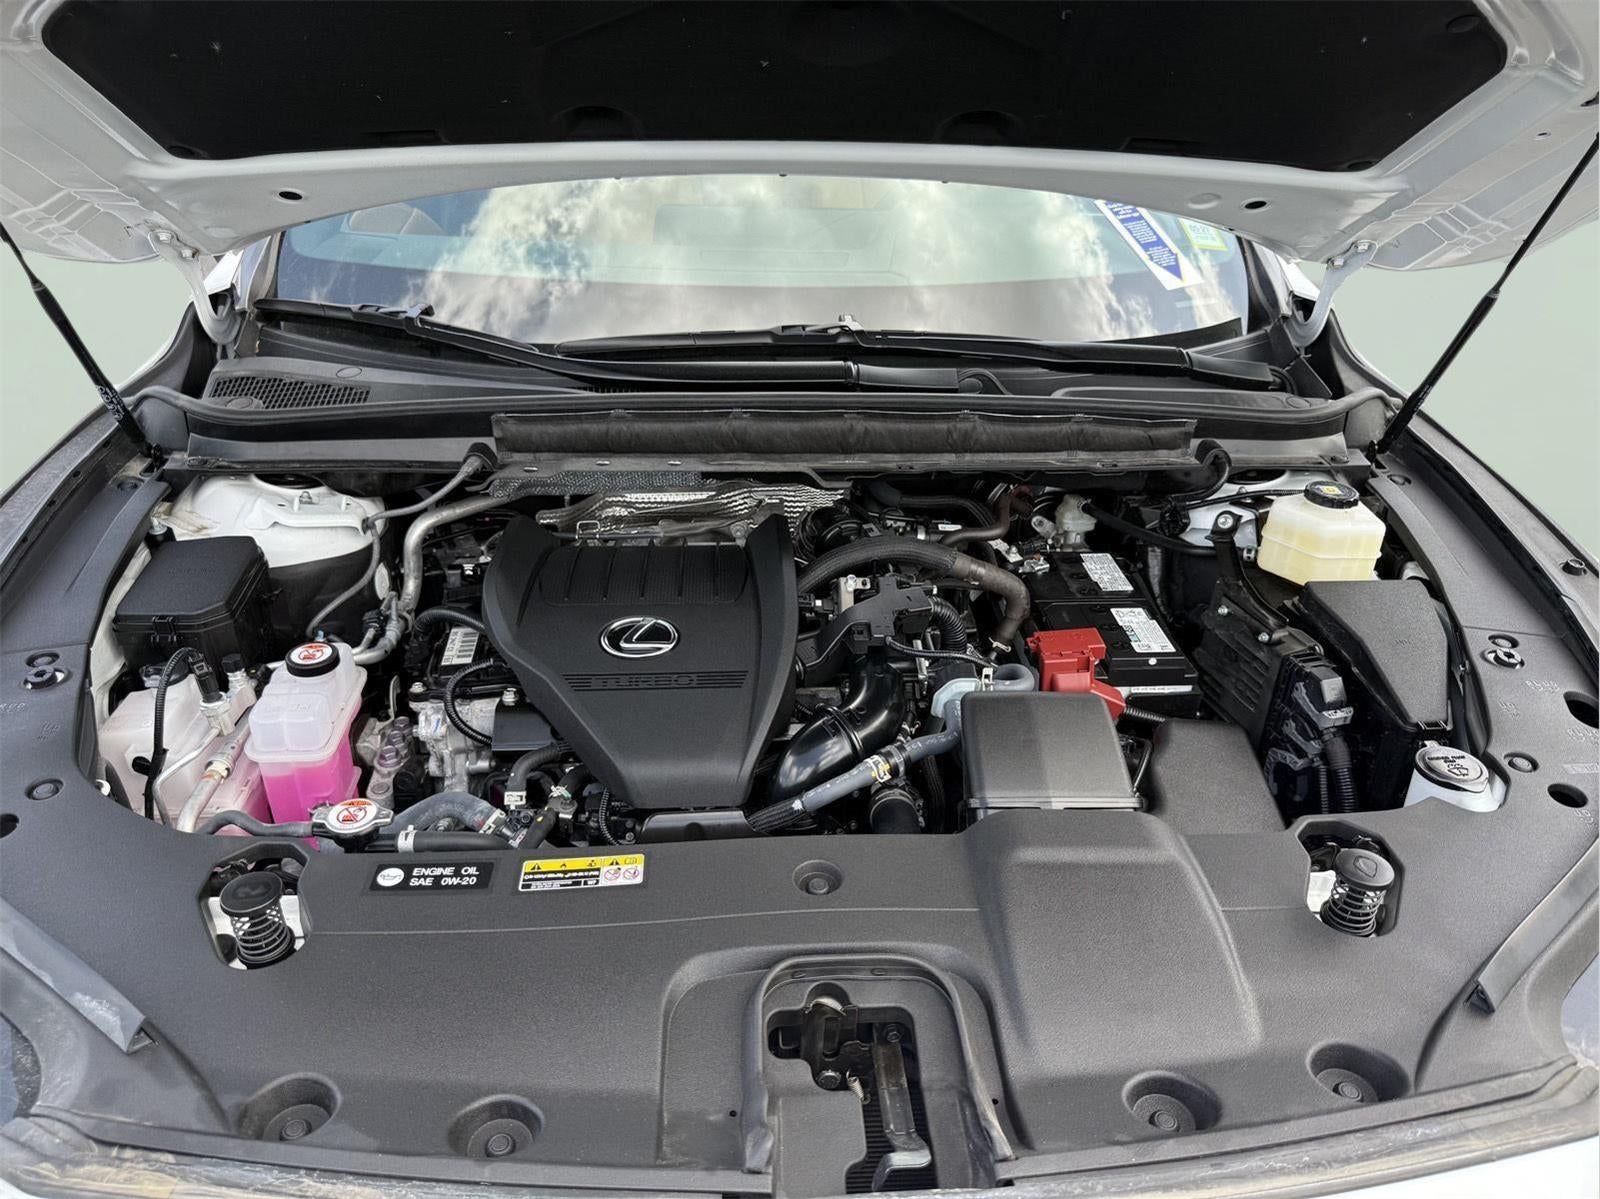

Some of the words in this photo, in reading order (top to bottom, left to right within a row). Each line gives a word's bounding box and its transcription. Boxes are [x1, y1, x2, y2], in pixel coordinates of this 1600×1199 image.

[594, 675, 694, 687] TURBO
[412, 867, 455, 876] ENGINE
[461, 866, 480, 875] OIL
[409, 877, 434, 886] SAE
